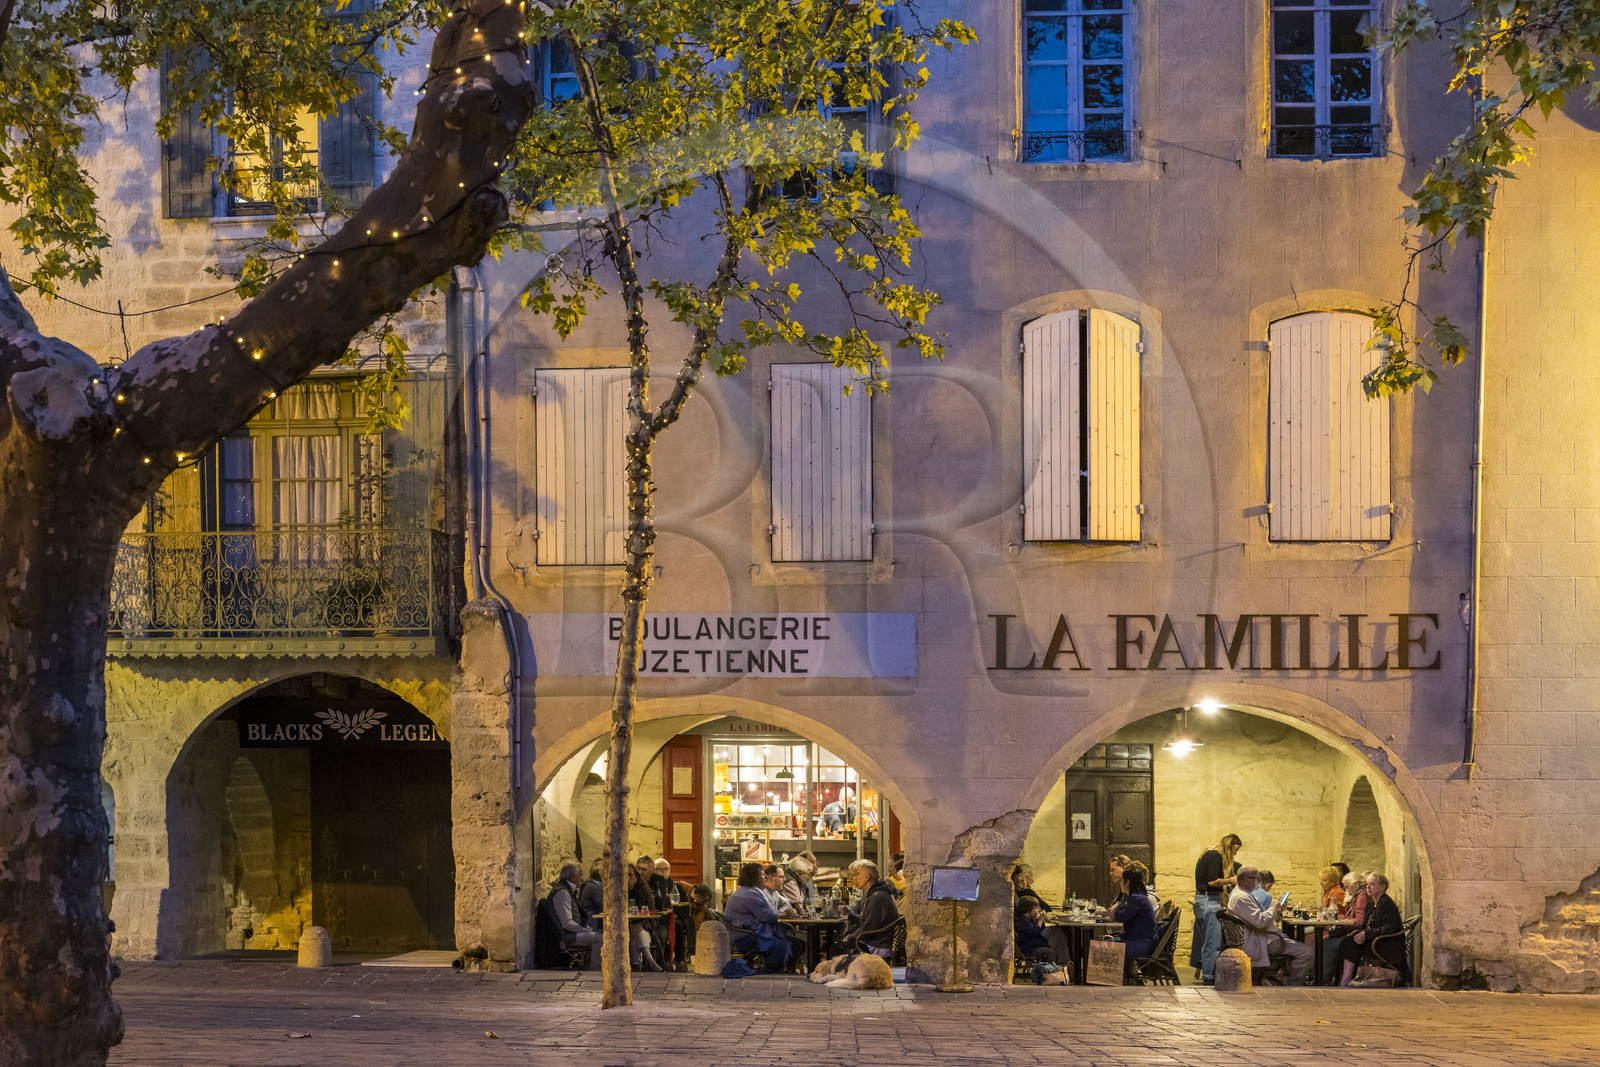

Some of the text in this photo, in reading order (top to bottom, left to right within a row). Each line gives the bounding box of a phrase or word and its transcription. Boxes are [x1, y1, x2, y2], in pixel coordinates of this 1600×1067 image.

[987, 613, 1441, 671] LA FAMILLE
[247, 723, 323, 741] BLACKS
[729, 723, 743, 732] LA
